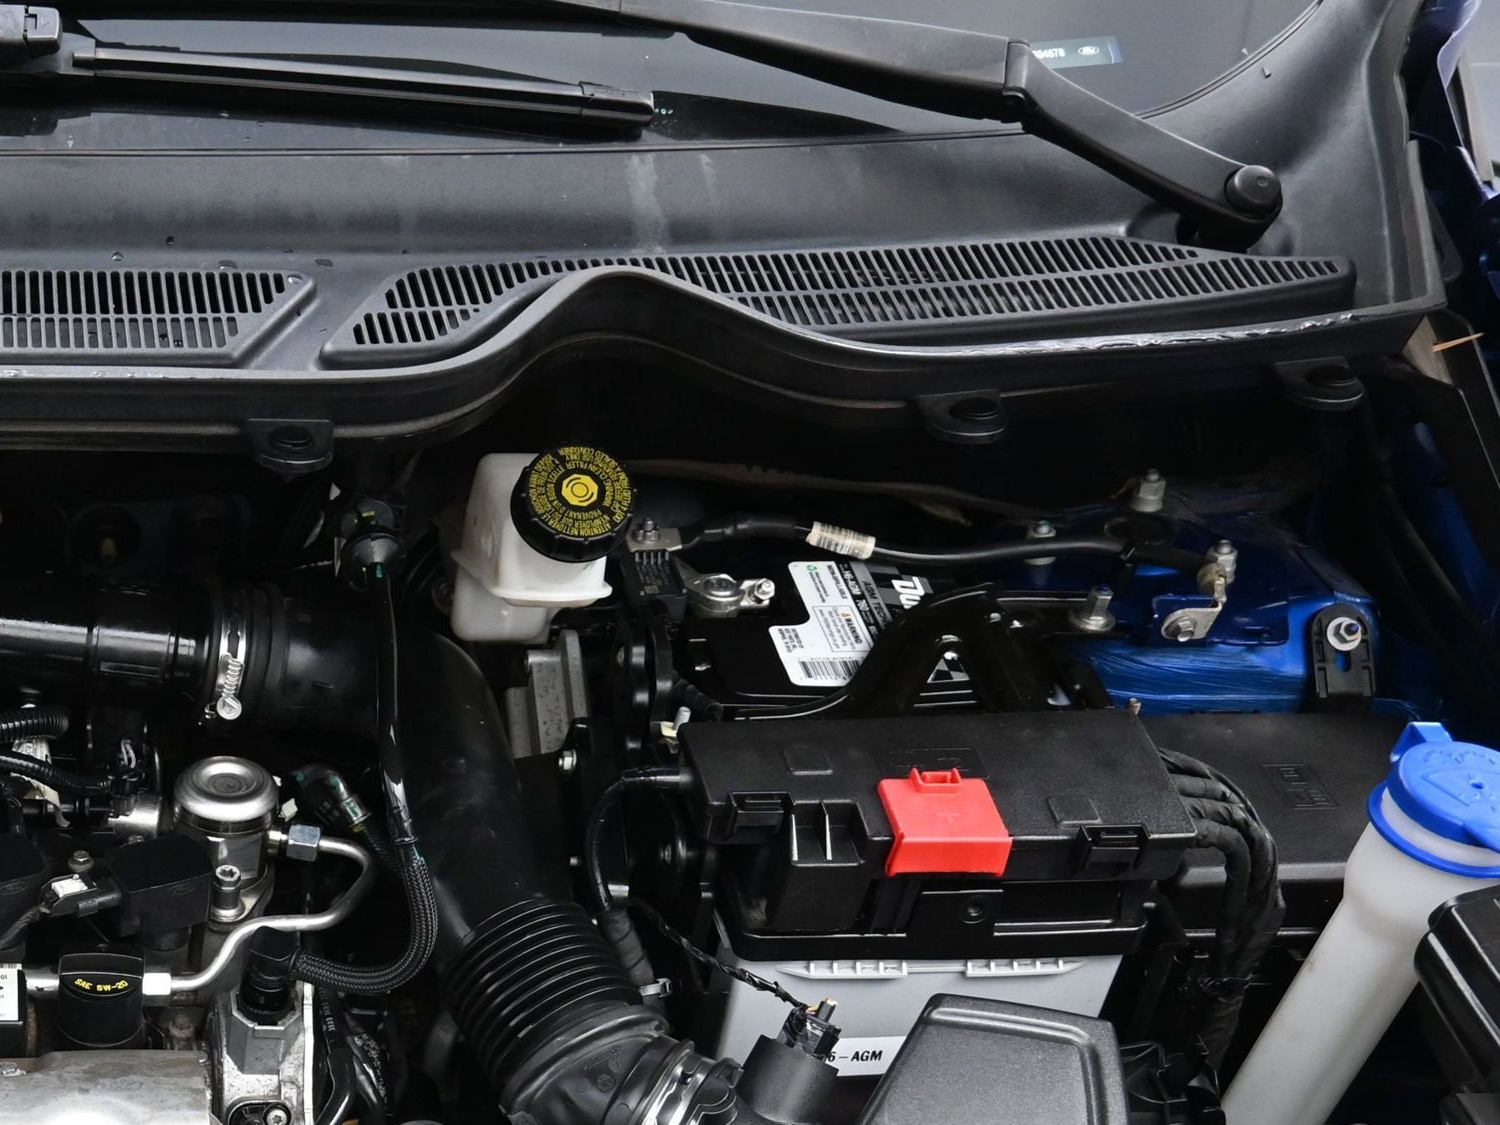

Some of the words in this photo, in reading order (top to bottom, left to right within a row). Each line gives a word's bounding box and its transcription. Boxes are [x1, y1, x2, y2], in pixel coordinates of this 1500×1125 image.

[564, 459, 589, 471] FILLER
[620, 489, 632, 507] FLUID
[544, 516, 578, 536] NETTOYER
[578, 520, 612, 537] ATTENTION
[74, 978, 93, 991] SAE
[96, 979, 129, 992] 5W-20
[850, 1050, 884, 1062] AGM
